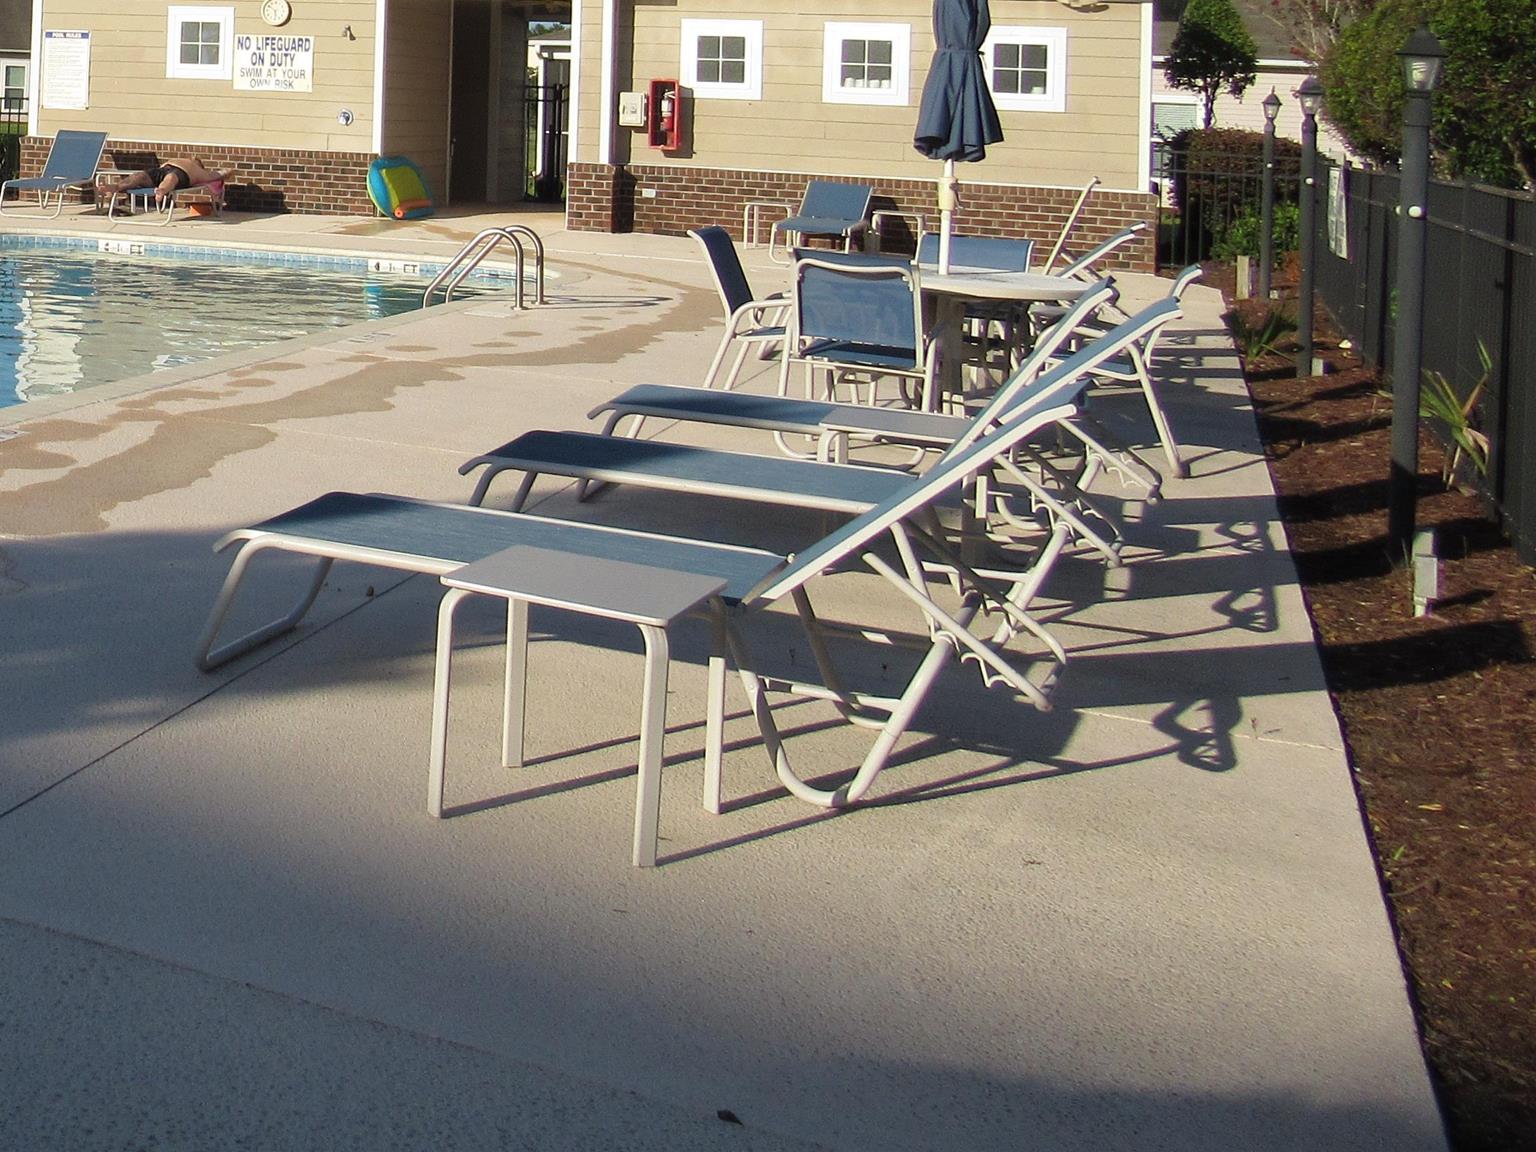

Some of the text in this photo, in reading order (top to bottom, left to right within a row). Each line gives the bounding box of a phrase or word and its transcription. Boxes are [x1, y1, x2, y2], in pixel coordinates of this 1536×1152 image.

[237, 36, 311, 52] NO LIFEGUARD
[251, 52, 296, 67] ON DUTY
[240, 67, 306, 79] SWIM AT YOUR
[250, 78, 295, 90] OWN RISK
